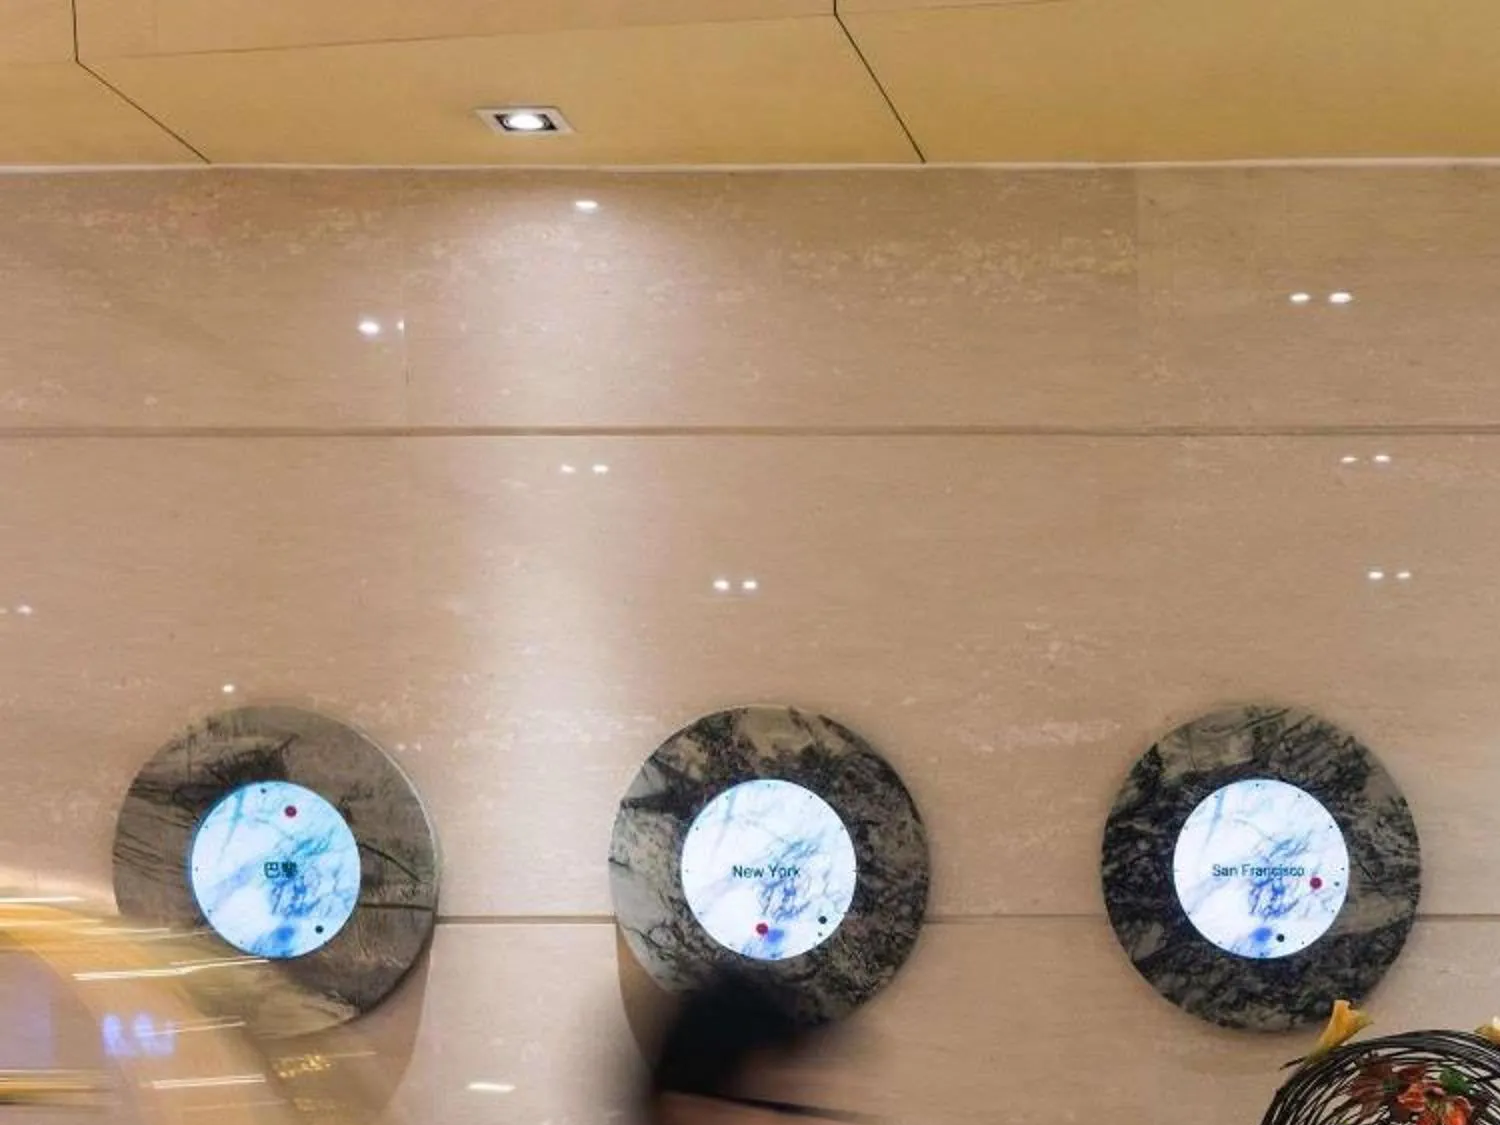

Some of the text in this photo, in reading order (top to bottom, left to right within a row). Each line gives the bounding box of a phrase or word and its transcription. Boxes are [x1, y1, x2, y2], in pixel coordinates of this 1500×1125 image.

[732, 863, 801, 878] New York
[1212, 863, 1305, 877] San Francisco
